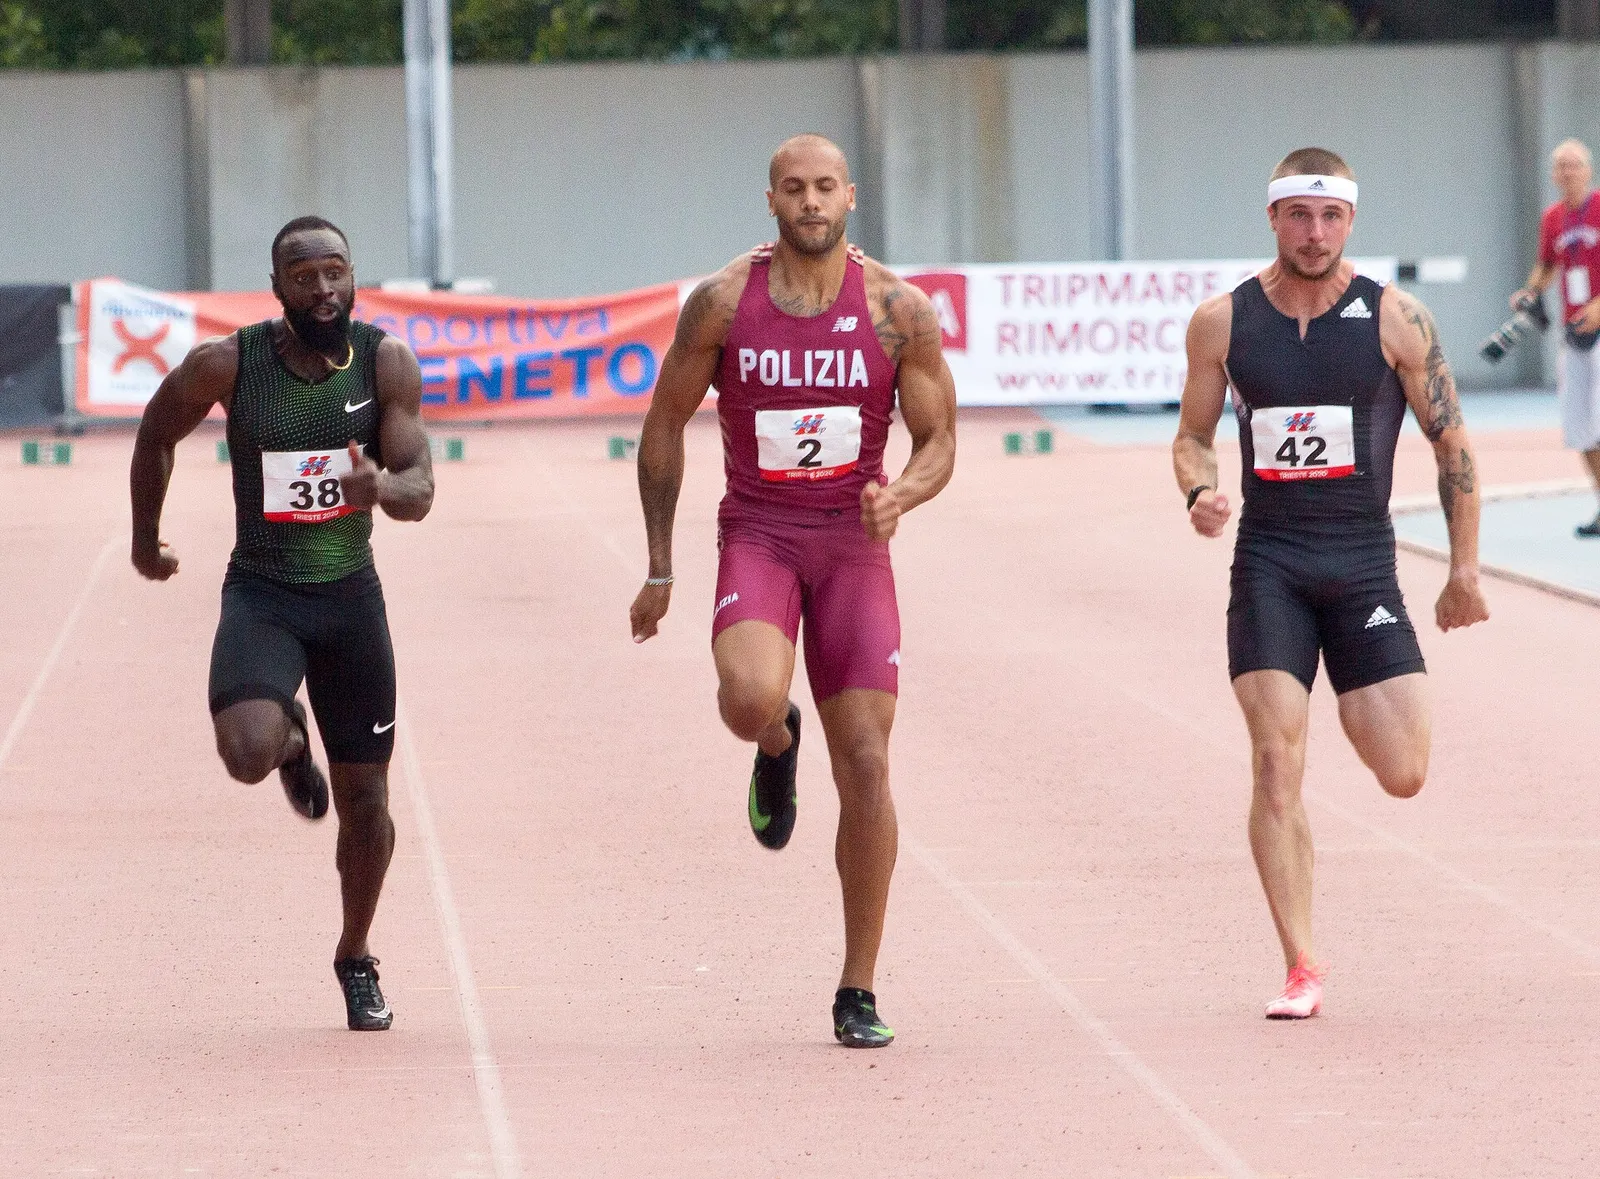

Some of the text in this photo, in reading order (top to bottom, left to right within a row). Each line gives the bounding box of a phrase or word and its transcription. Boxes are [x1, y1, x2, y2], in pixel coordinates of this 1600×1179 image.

[994, 272, 1219, 308] TRIPMARE
[998, 318, 1186, 356] RIMORC
[420, 342, 657, 405] ENETO
[738, 348, 869, 387] POLIZIA
[797, 438, 822, 467] 2
[1275, 436, 1328, 467] 42
[289, 478, 341, 510] 38
[292, 510, 340, 521] TRIESTE 2020
